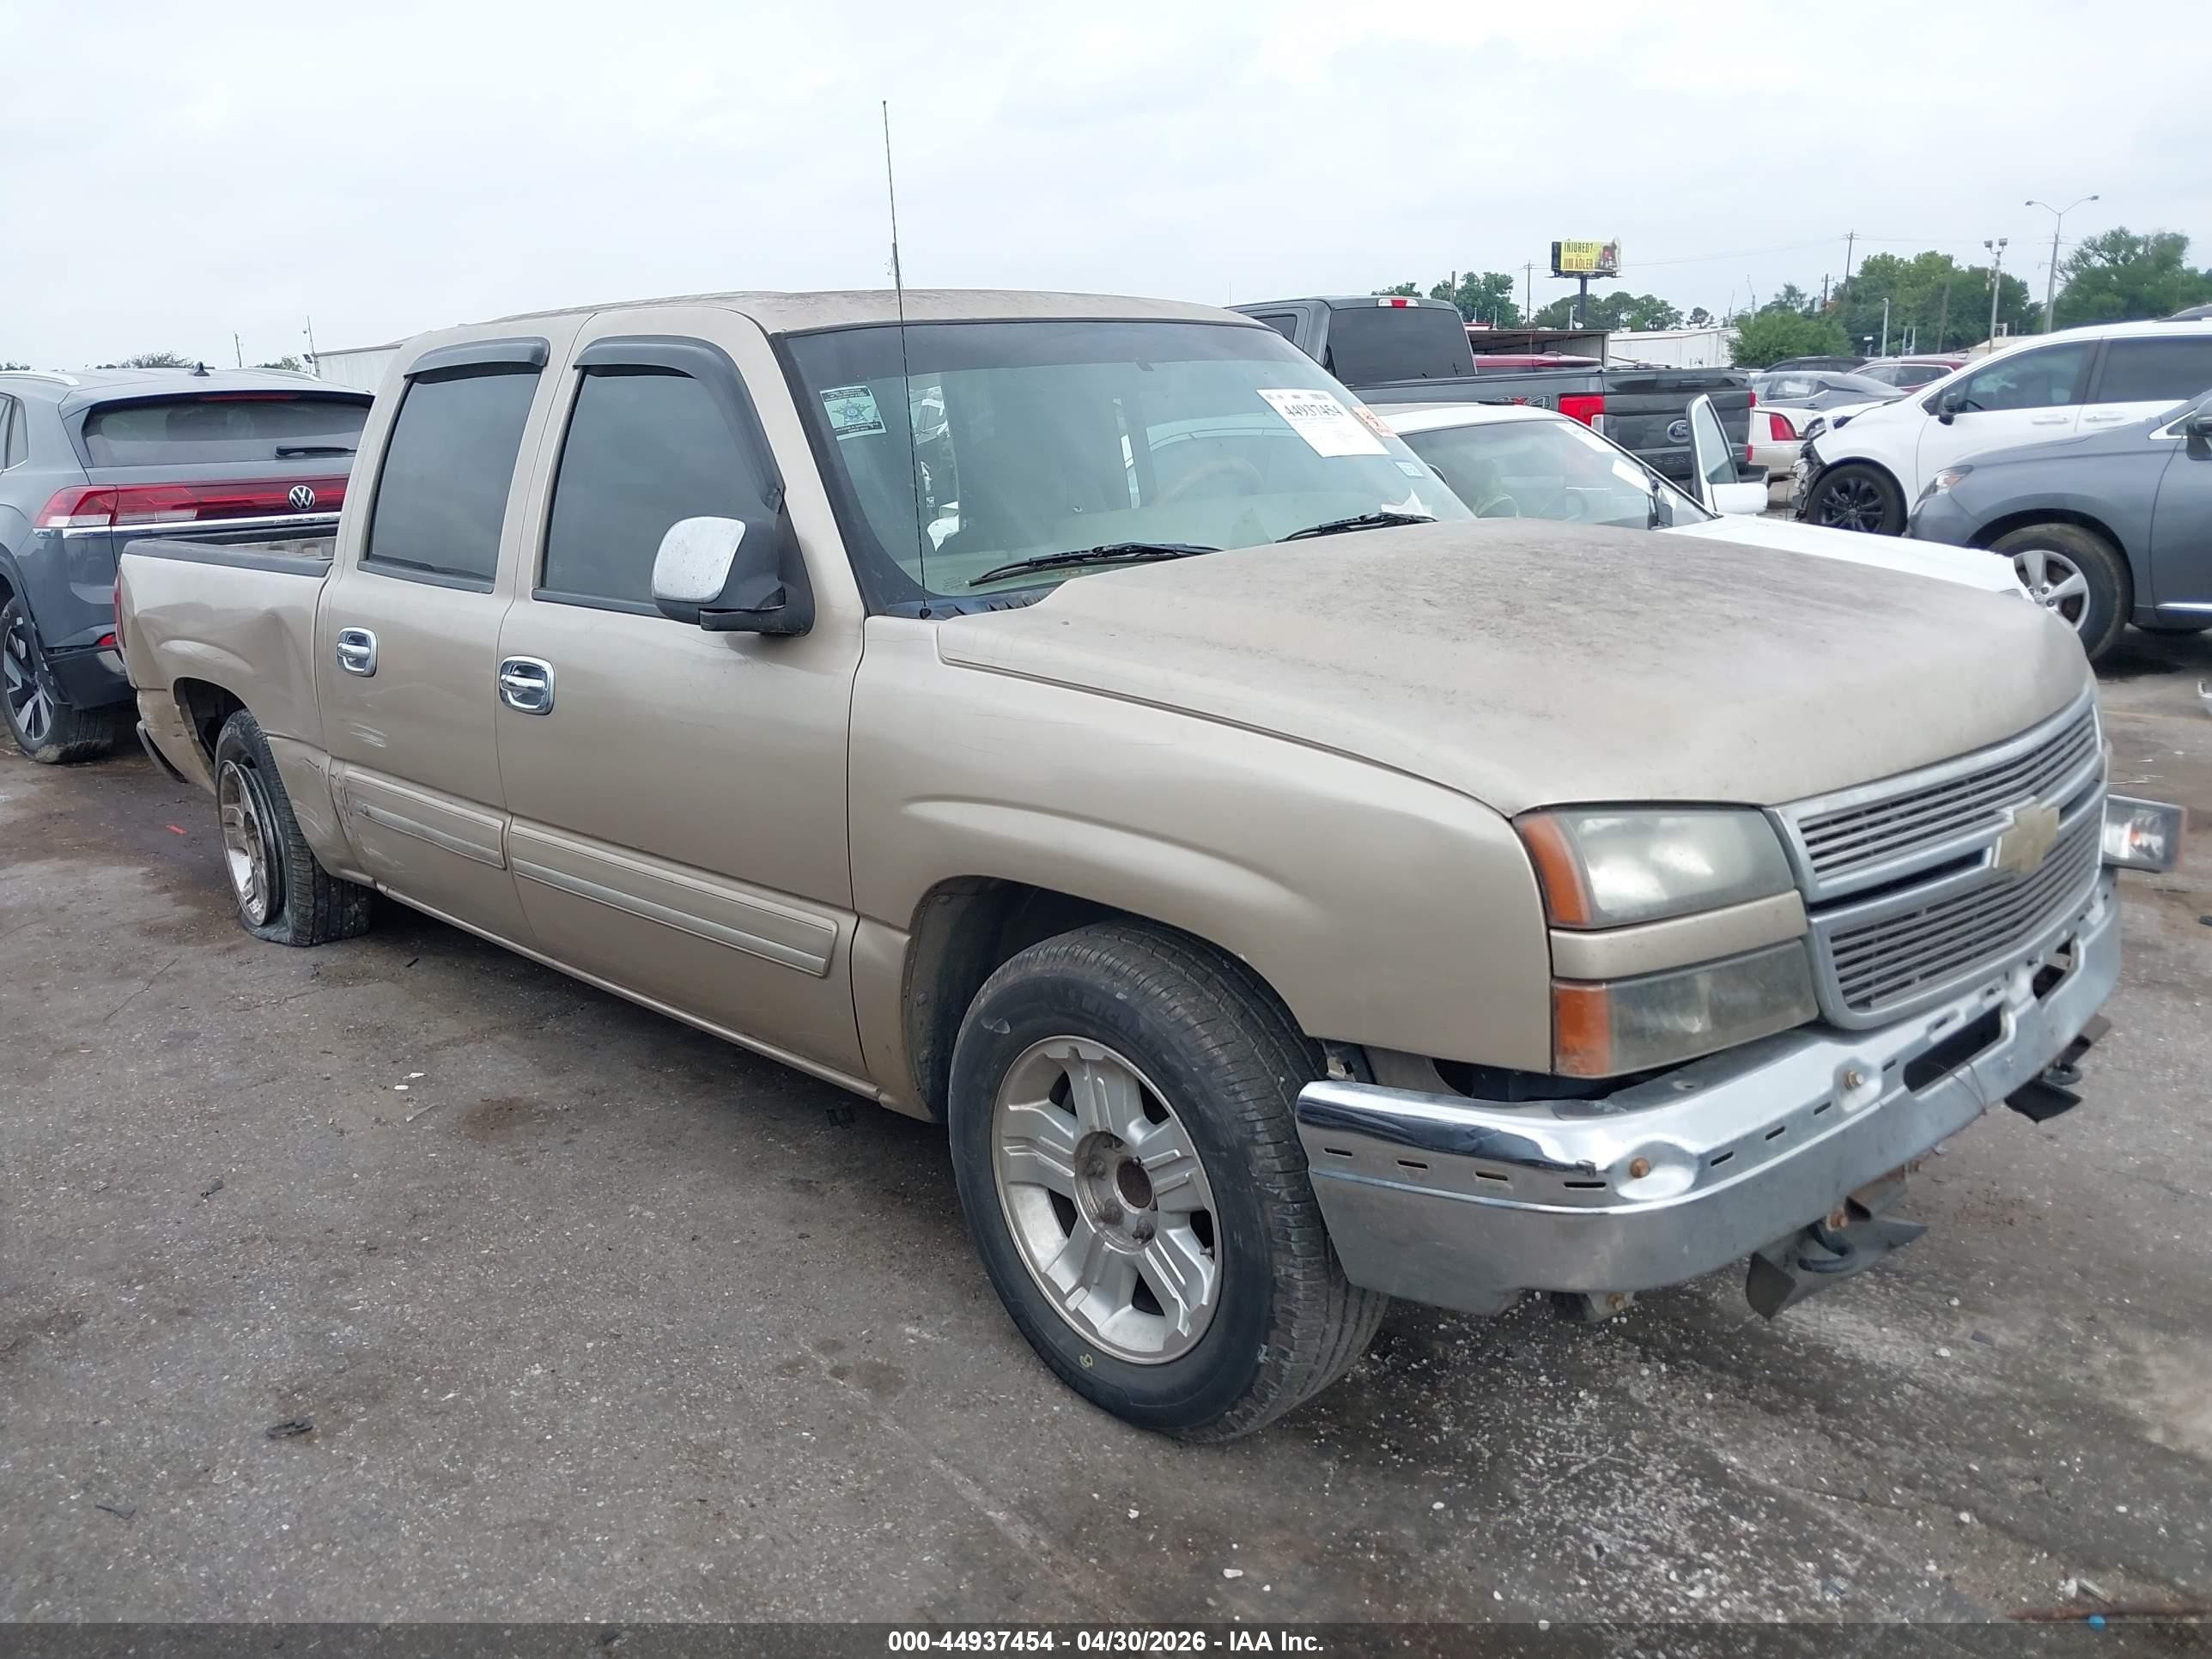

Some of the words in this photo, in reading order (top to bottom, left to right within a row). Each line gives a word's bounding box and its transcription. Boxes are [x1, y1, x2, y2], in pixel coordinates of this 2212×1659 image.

[1564, 241, 1593, 253] INJURED?
[1562, 258, 1573, 270] JIM
[1575, 258, 1593, 270] ADLER
[1284, 404, 1344, 417] 44937454
